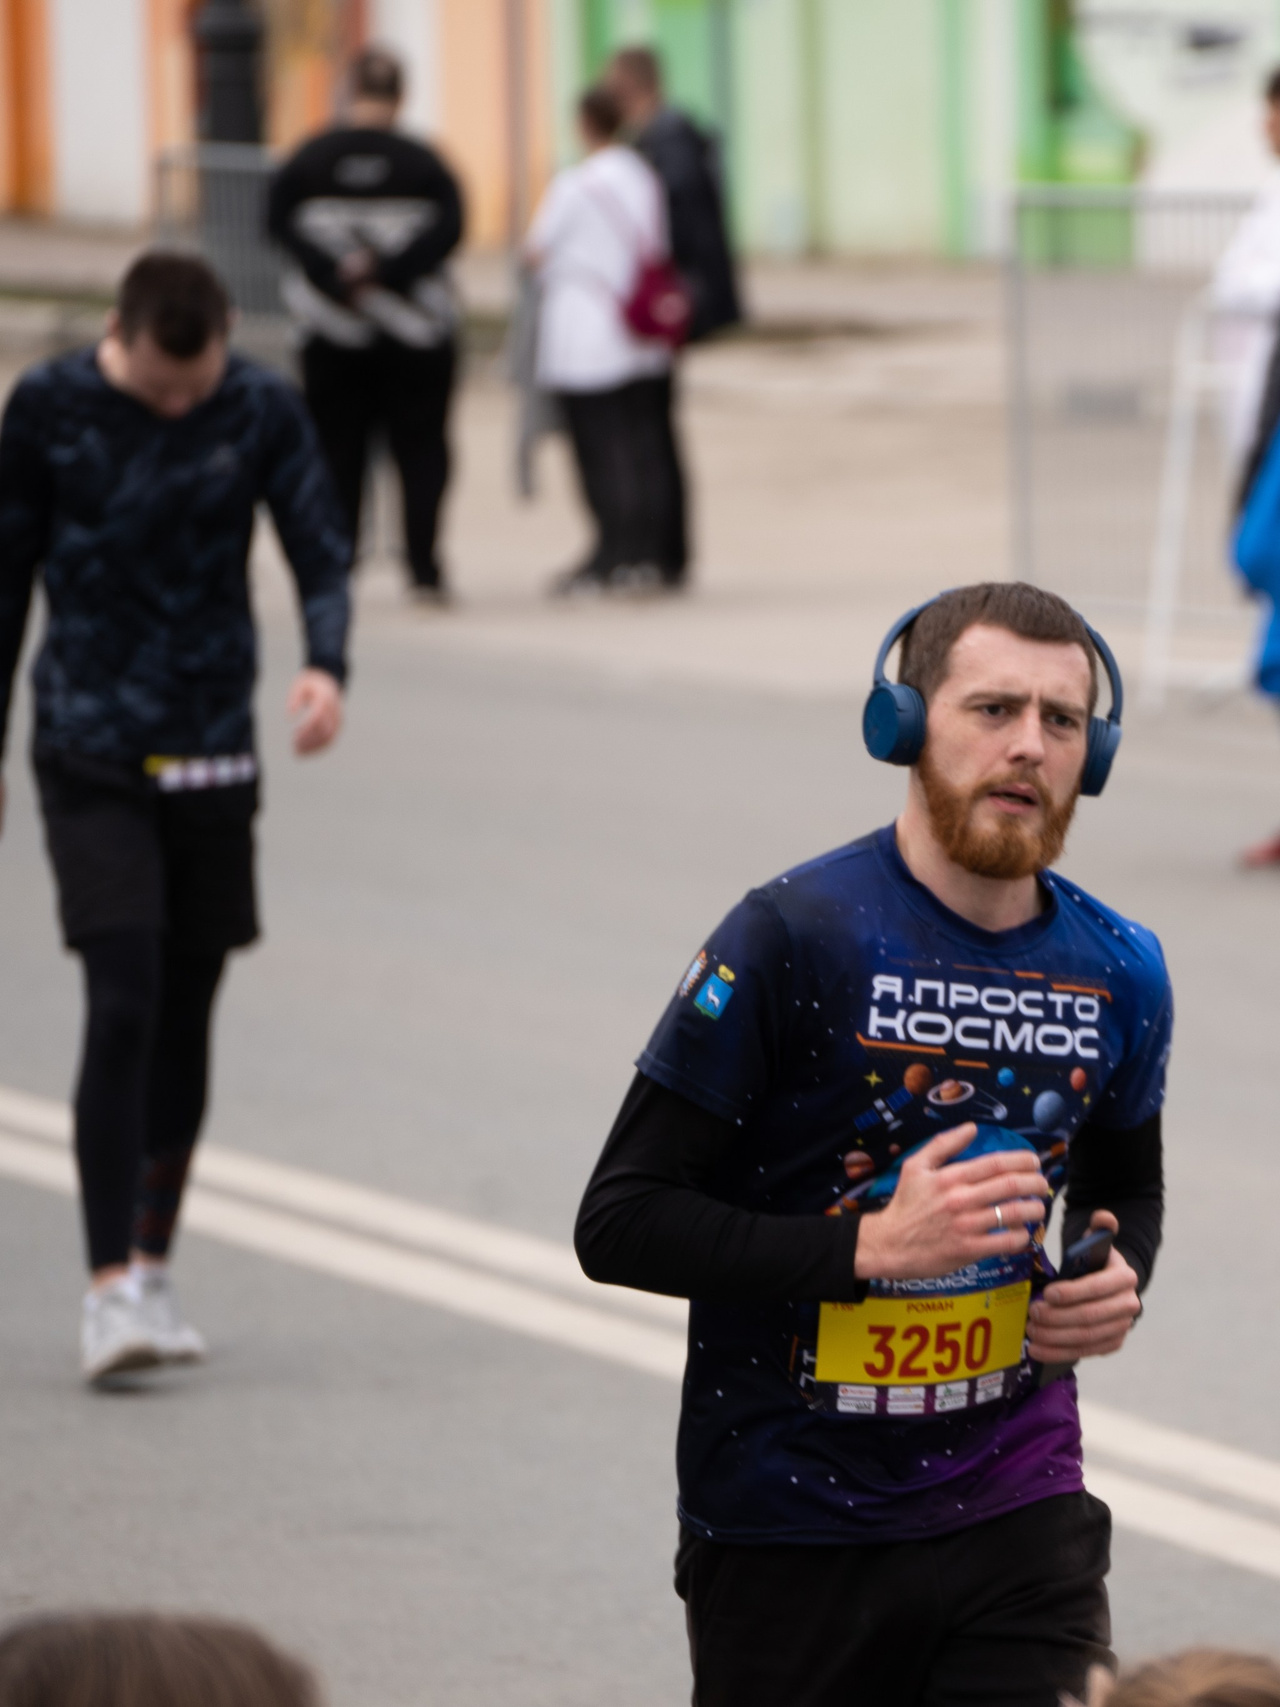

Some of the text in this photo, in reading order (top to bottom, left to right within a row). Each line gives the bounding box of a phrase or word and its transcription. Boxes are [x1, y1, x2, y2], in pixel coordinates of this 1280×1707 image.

[868, 1005, 1100, 1059] КОСМОС
[906, 1300, 954, 1314] РОМАН
[863, 1316, 992, 1378] 3250
